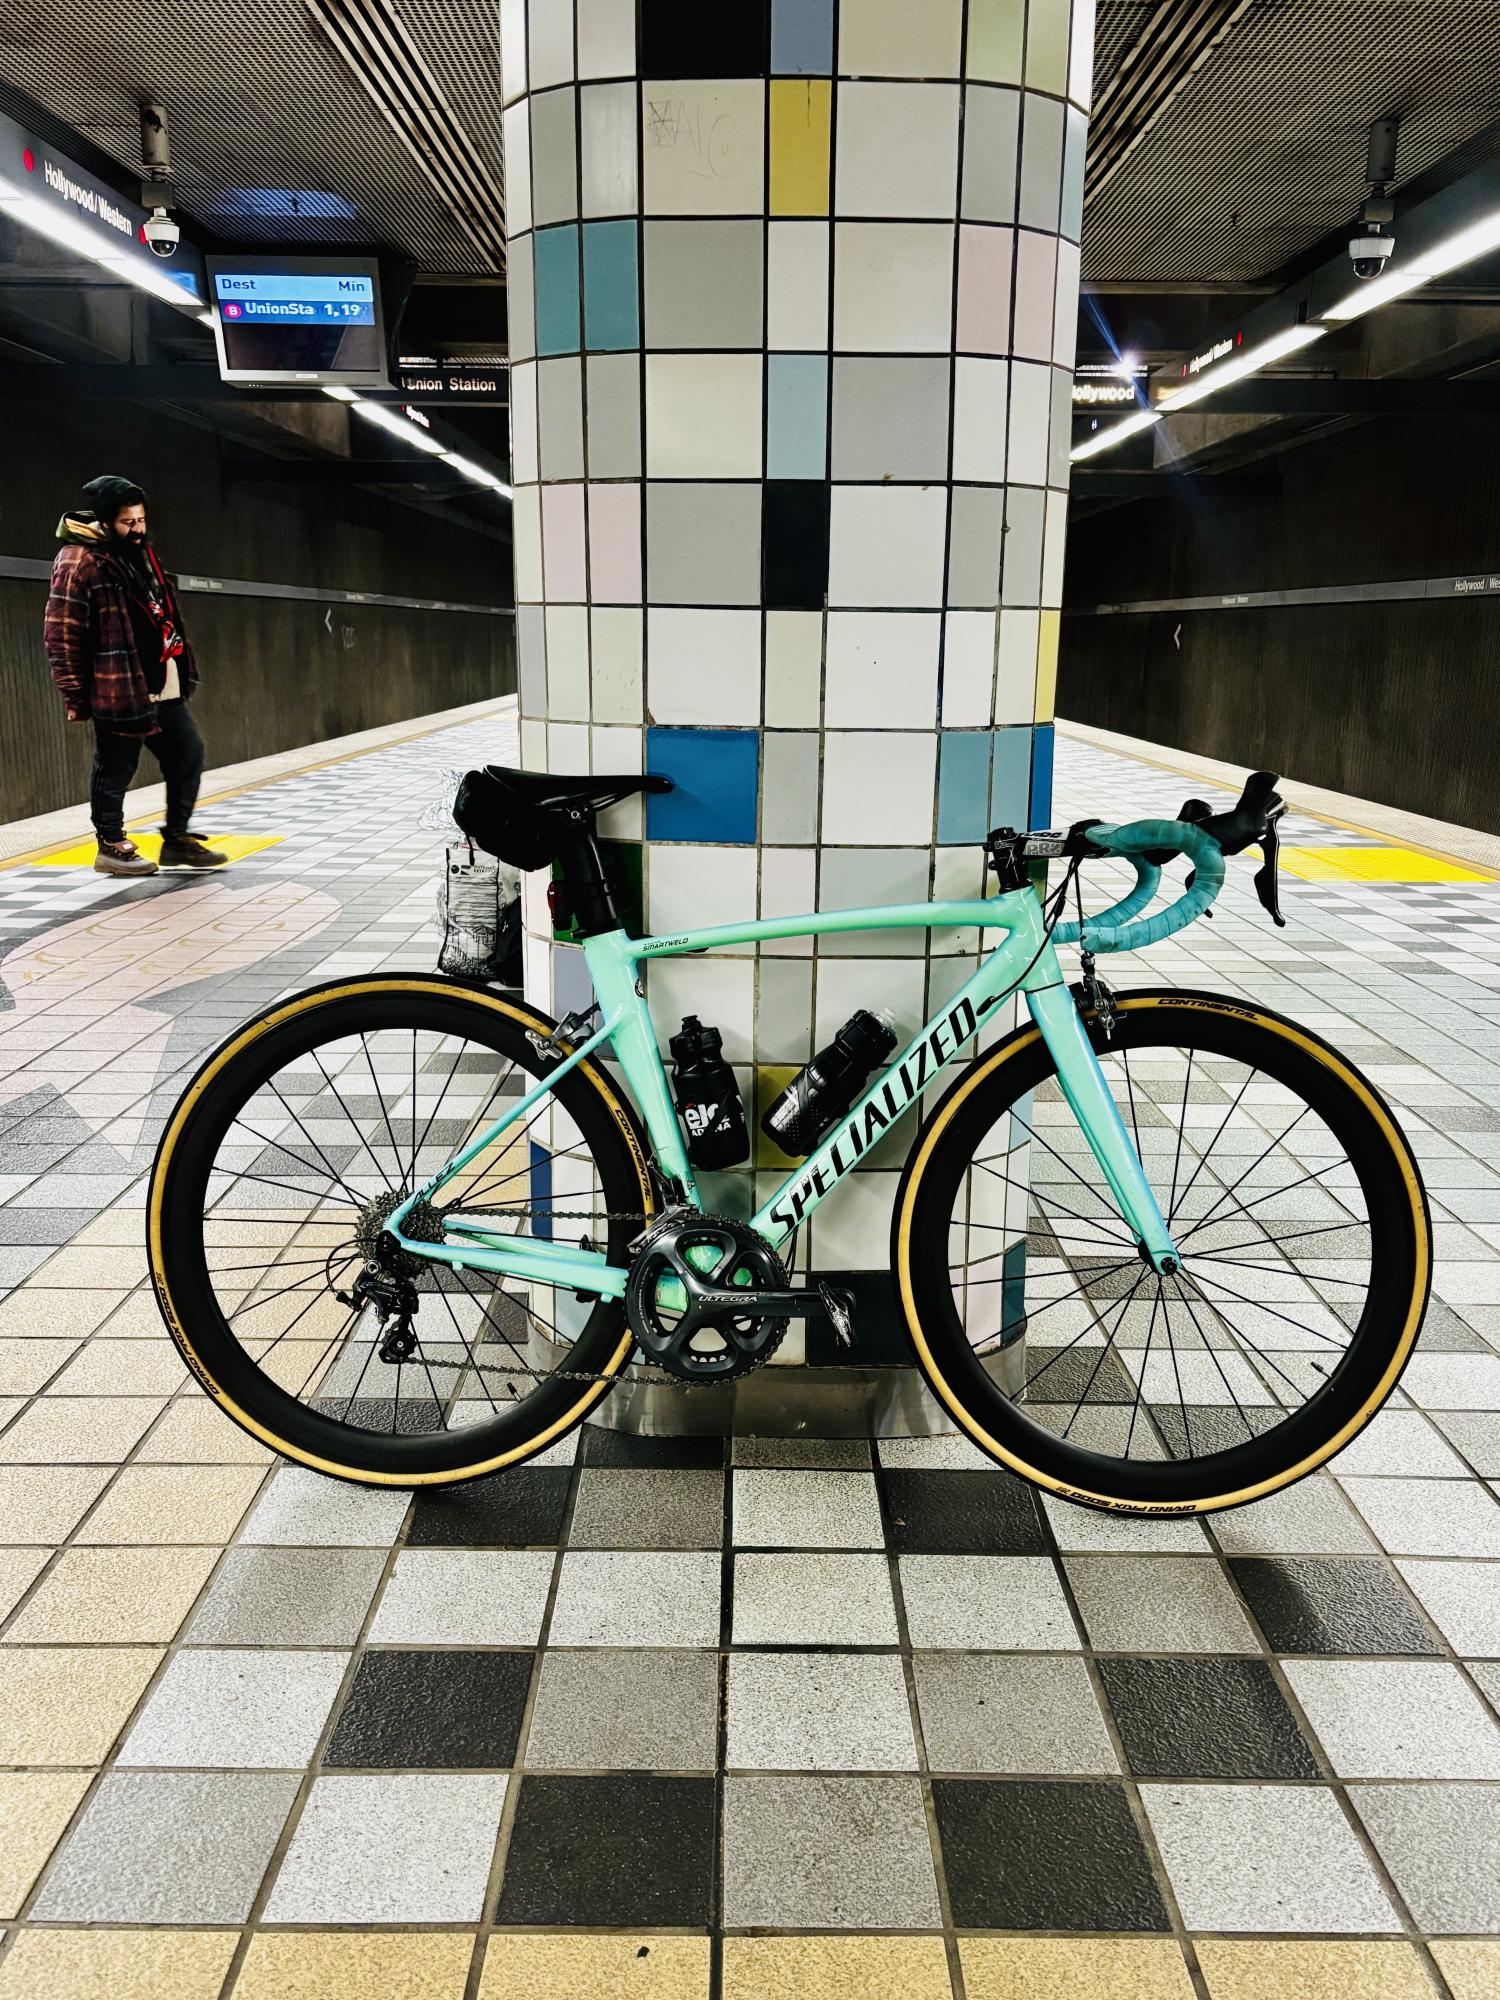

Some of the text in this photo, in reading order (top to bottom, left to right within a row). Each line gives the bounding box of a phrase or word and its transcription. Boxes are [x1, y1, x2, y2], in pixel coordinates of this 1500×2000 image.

[222, 278, 365, 292] Dest Min
[245, 302, 315, 316] UnionSta
[406, 377, 497, 391] Union Station
[1454, 579, 1485, 593] Hollywood
[642, 938, 689, 952] SMARTWELD
[1157, 998, 1260, 1021] CONTINENTAL
[770, 997, 977, 1244] SPECIALIZED
[615, 1109, 651, 1201] CONTINENTAL
[698, 1295, 758, 1303] ULTEGRA
[1069, 1491, 1112, 1507] 5000
[1111, 1502, 1148, 1512] PRIX
[1148, 1504, 1197, 1512] GRAND
